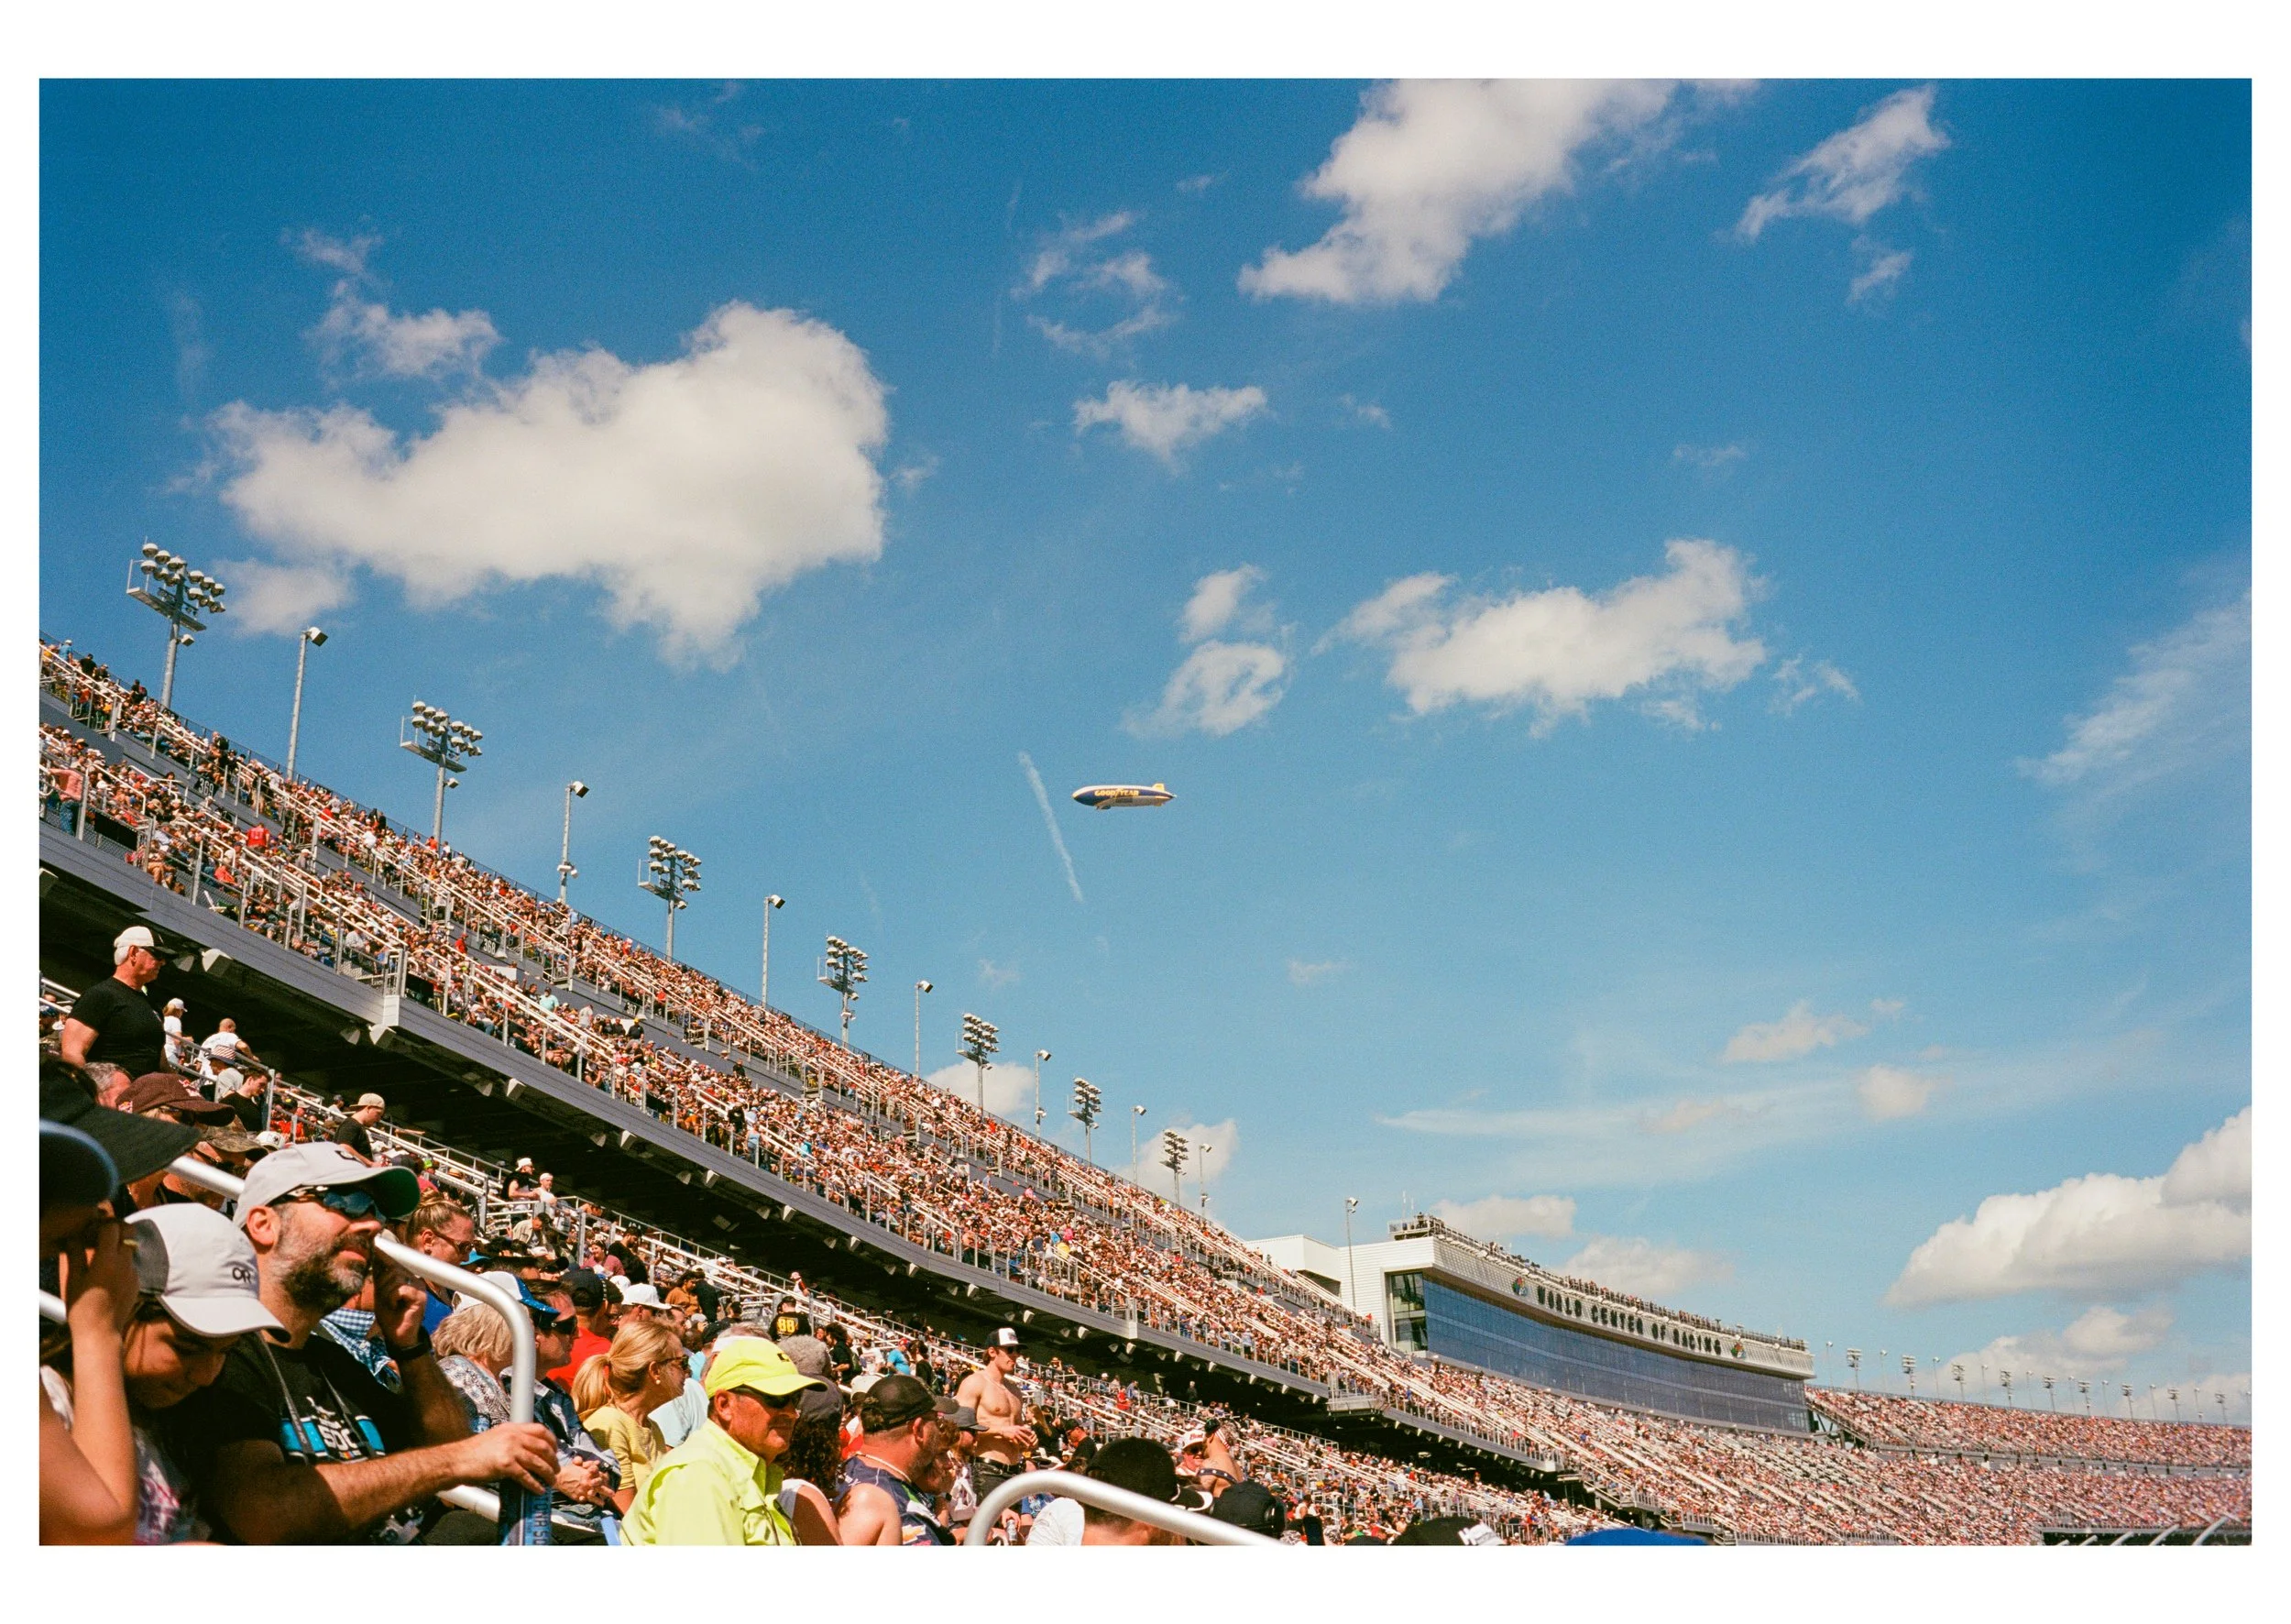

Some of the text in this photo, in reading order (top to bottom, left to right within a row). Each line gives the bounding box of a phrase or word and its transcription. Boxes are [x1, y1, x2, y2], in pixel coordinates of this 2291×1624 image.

[199, 778, 214, 797] 369
[1094, 788, 1139, 797] GOODYEAR
[483, 938, 496, 954] 368
[232, 1267, 251, 1284] OR
[777, 1318, 795, 1333] 88
[1538, 1285, 1722, 1355] WORLD CENTER OF RACING
